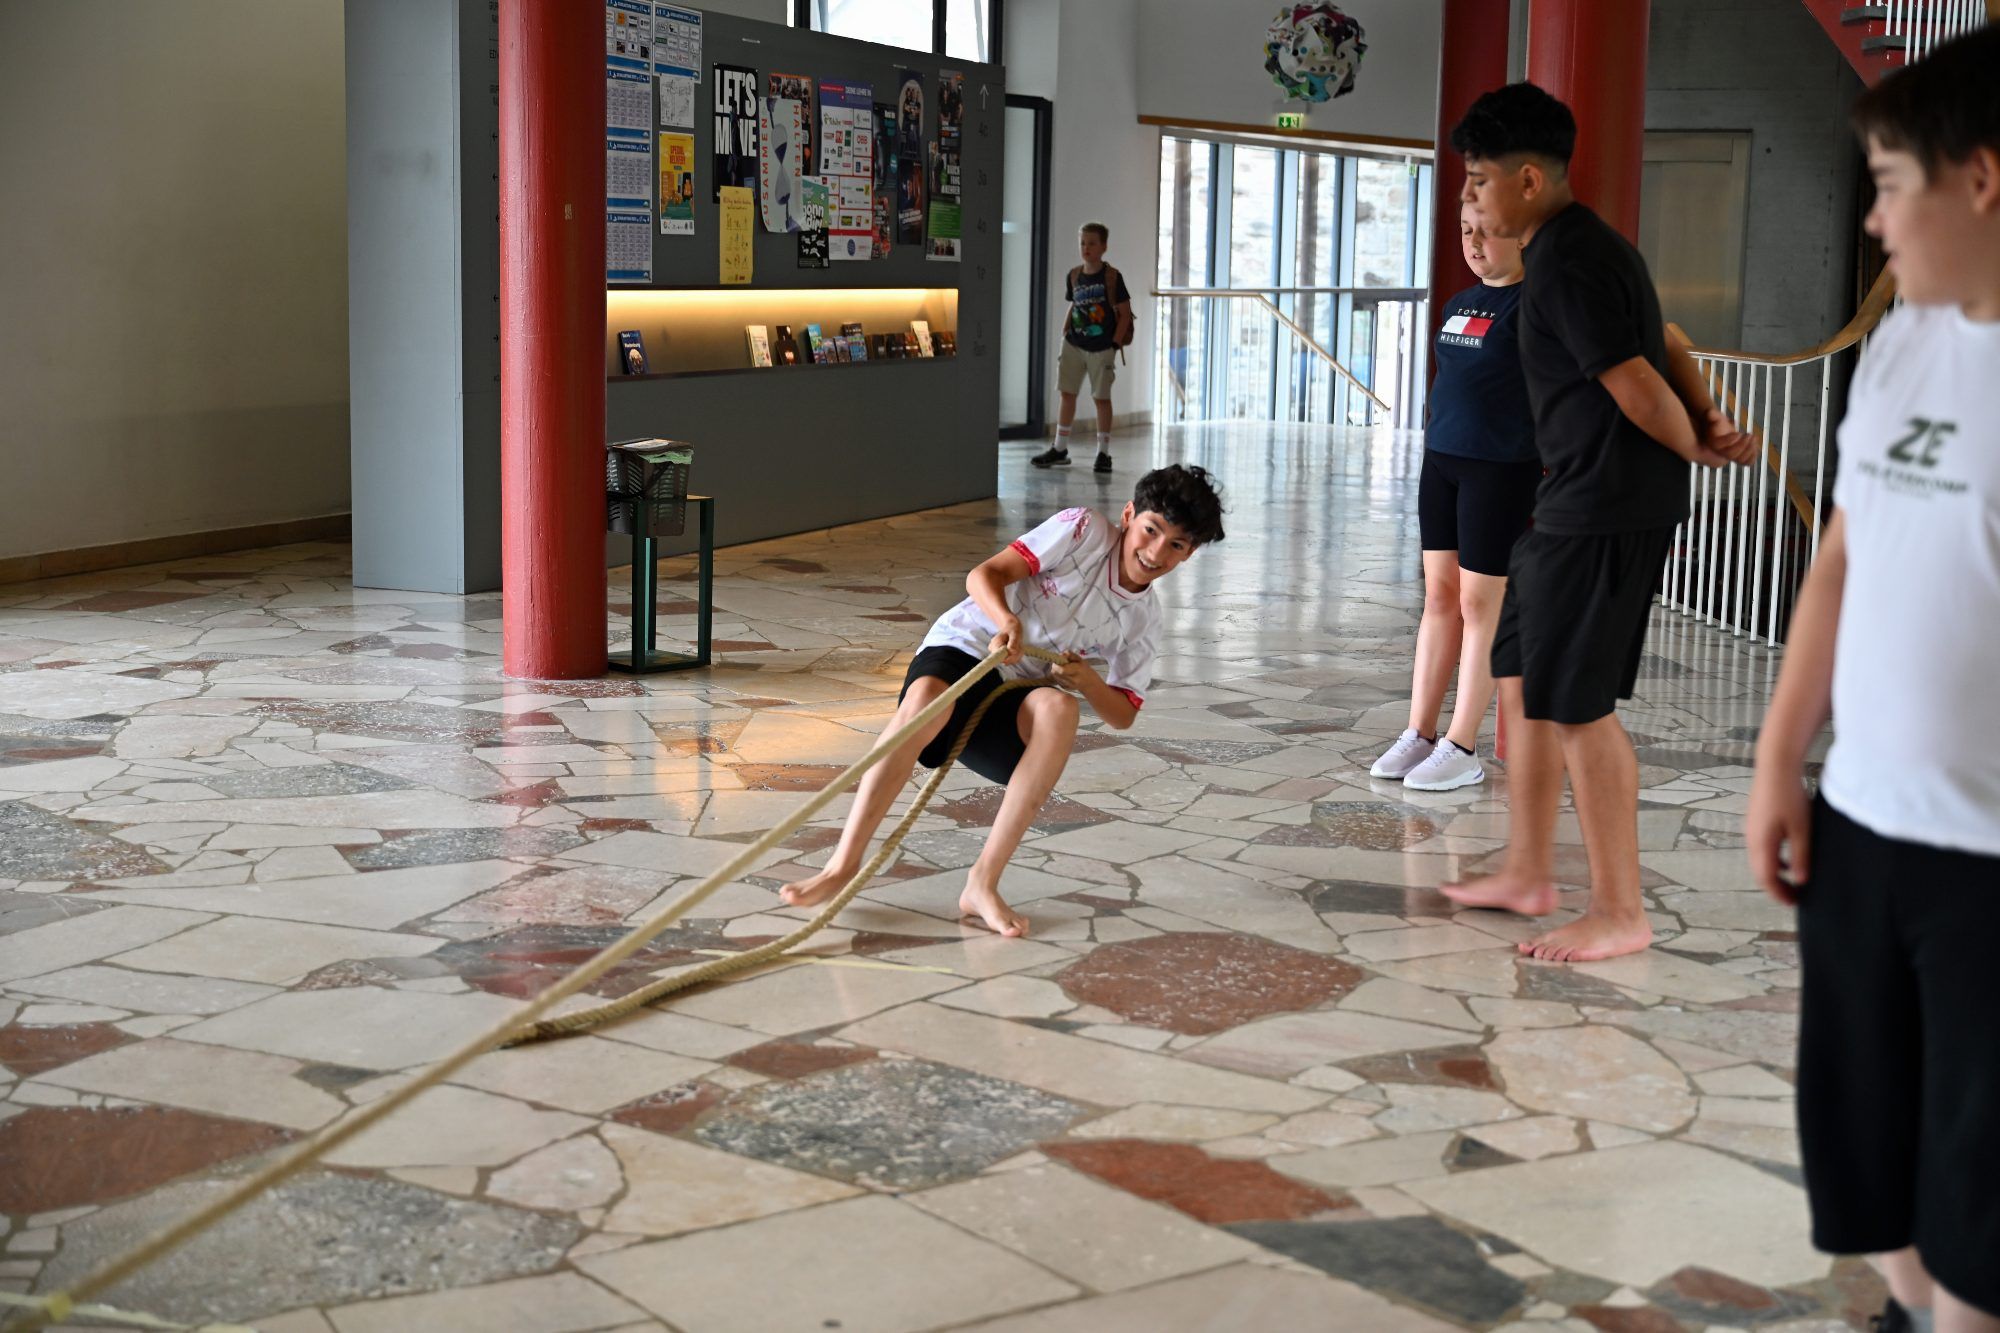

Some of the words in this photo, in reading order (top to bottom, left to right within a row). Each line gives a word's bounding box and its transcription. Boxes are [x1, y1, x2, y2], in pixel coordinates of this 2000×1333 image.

[715, 69, 757, 117] LET'S
[793, 104, 801, 177] HALTEN
[1458, 308, 1495, 318] TOMMY
[1440, 334, 1479, 346] HILFIGER
